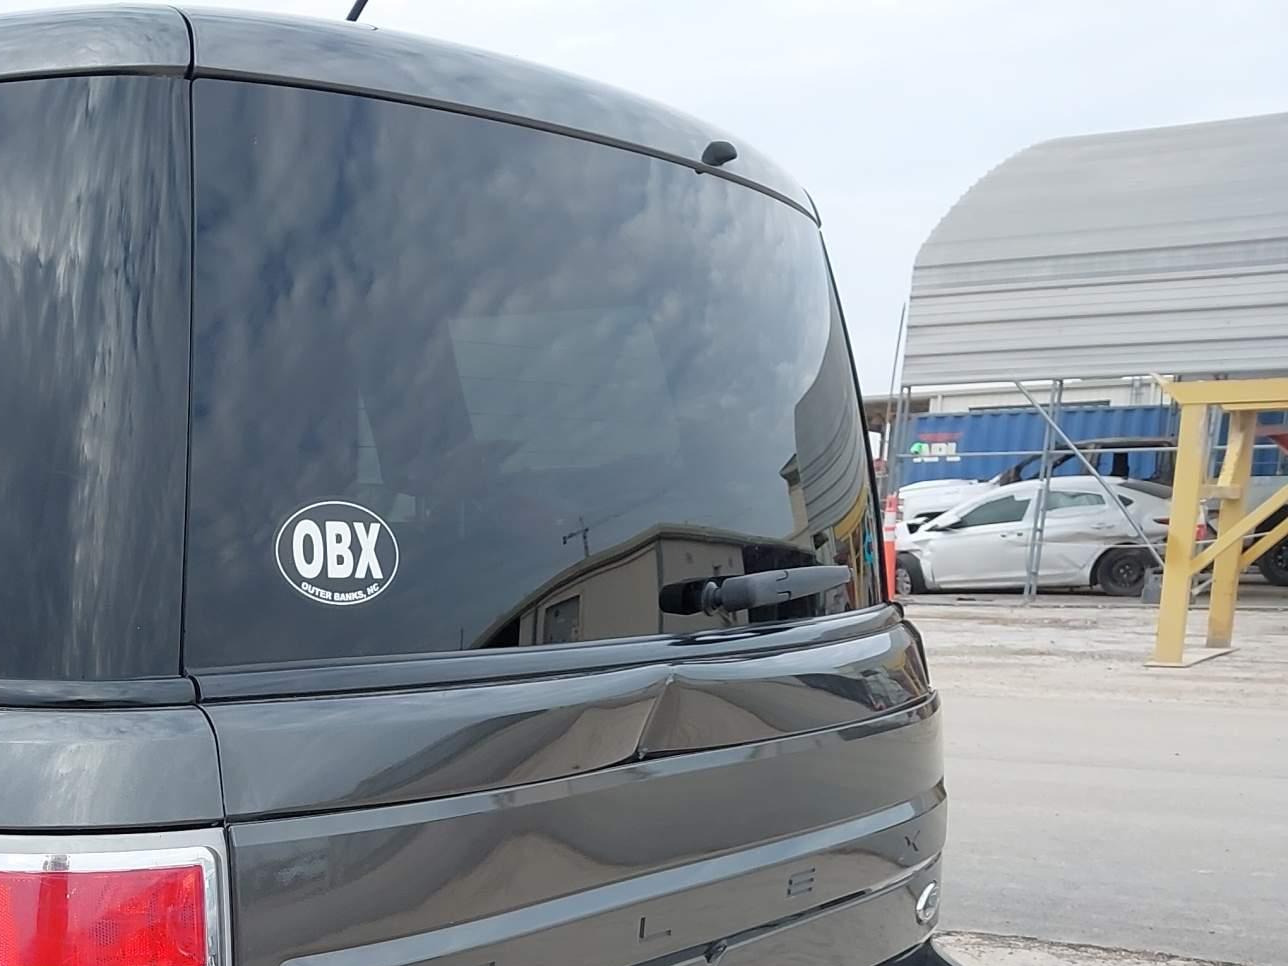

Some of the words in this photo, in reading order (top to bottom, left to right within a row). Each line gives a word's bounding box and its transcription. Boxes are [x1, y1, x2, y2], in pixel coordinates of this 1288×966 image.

[292, 519, 384, 579] OBX
[300, 581, 333, 600] OUTER
[333, 590, 367, 601] BANKS,
[367, 583, 380, 595] NC
